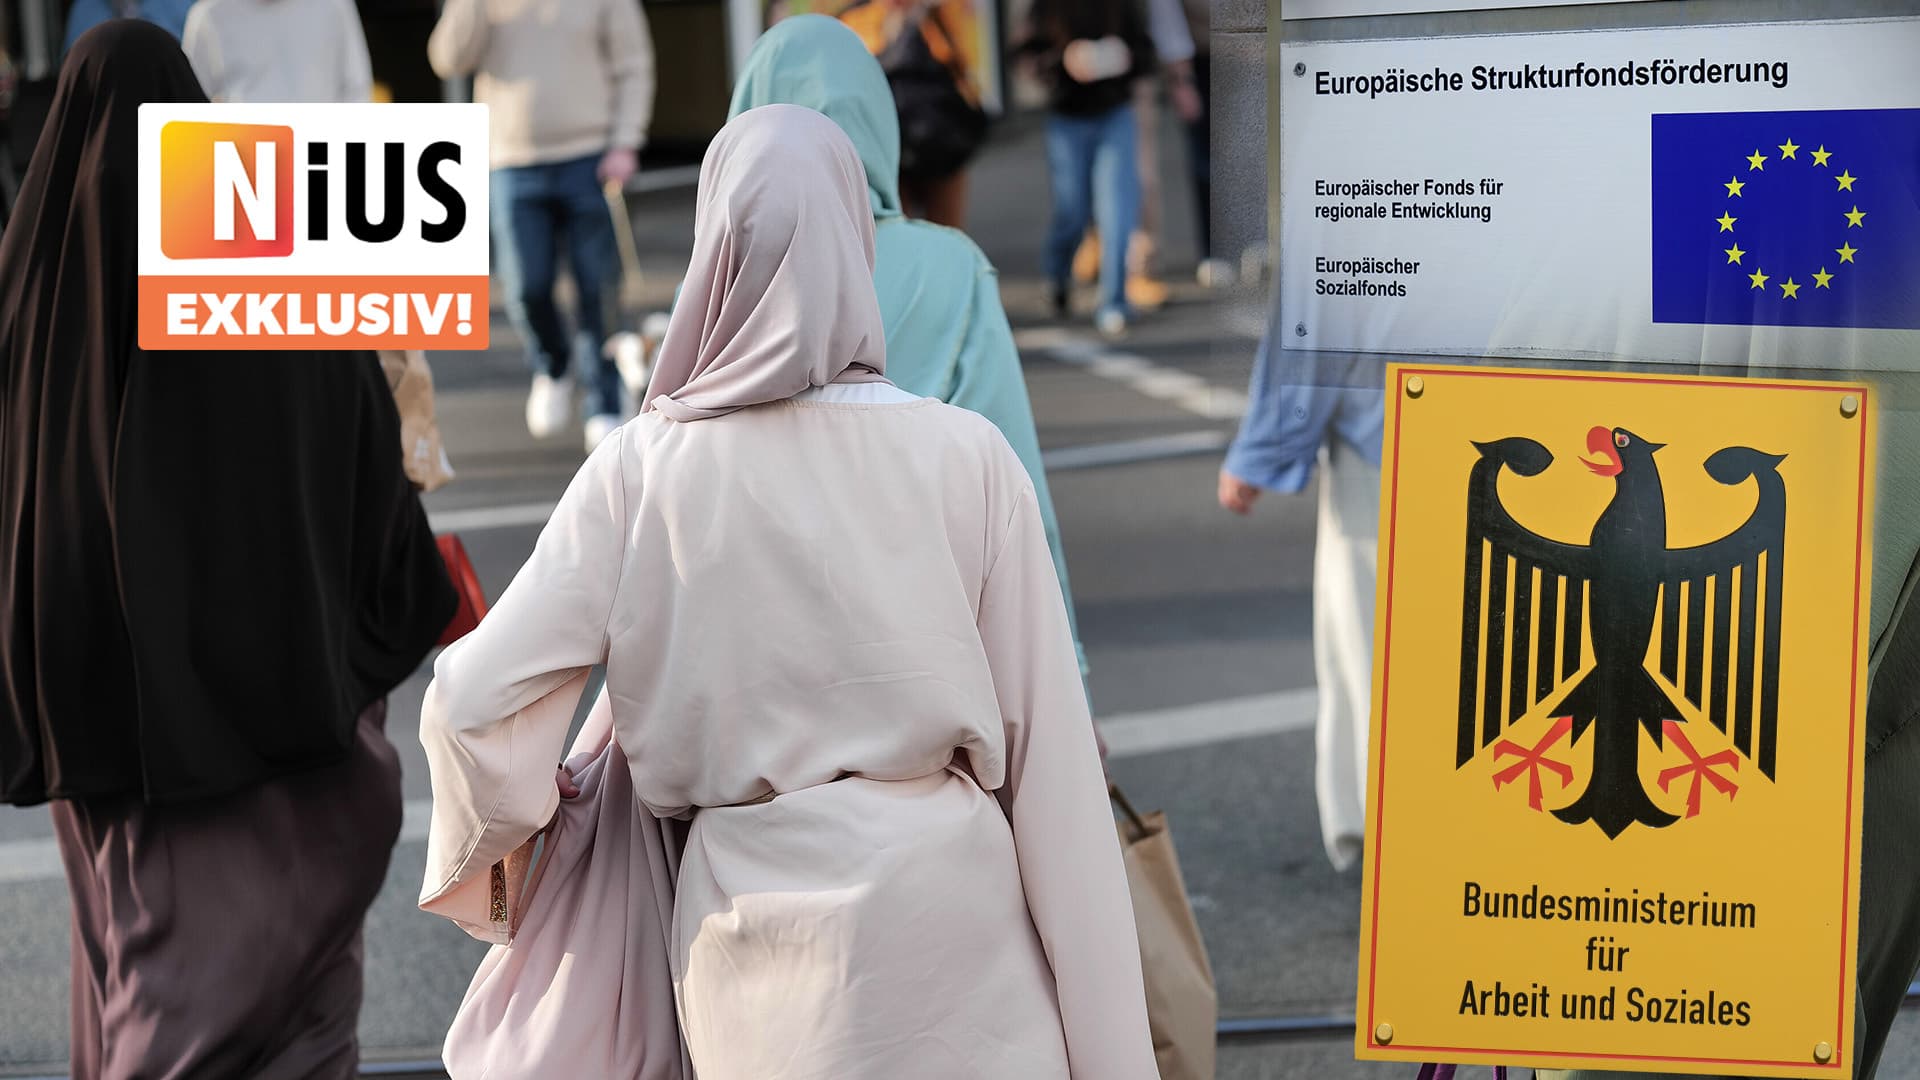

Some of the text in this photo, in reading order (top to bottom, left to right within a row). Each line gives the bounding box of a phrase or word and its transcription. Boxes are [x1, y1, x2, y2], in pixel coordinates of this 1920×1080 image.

[1315, 58, 1788, 99] Europäische Strukturfondsförderung
[1315, 179, 1503, 200] Europäischer Fonds für
[1315, 202, 1491, 223] regionale Entwicklung
[1315, 257, 1420, 278] Europäischer
[1315, 279, 1407, 297] Sozialfonds
[1464, 882, 1755, 928] Bundesministerium
[1586, 936, 1630, 972] für
[1459, 980, 1751, 1027] Arbeit und Soziales
